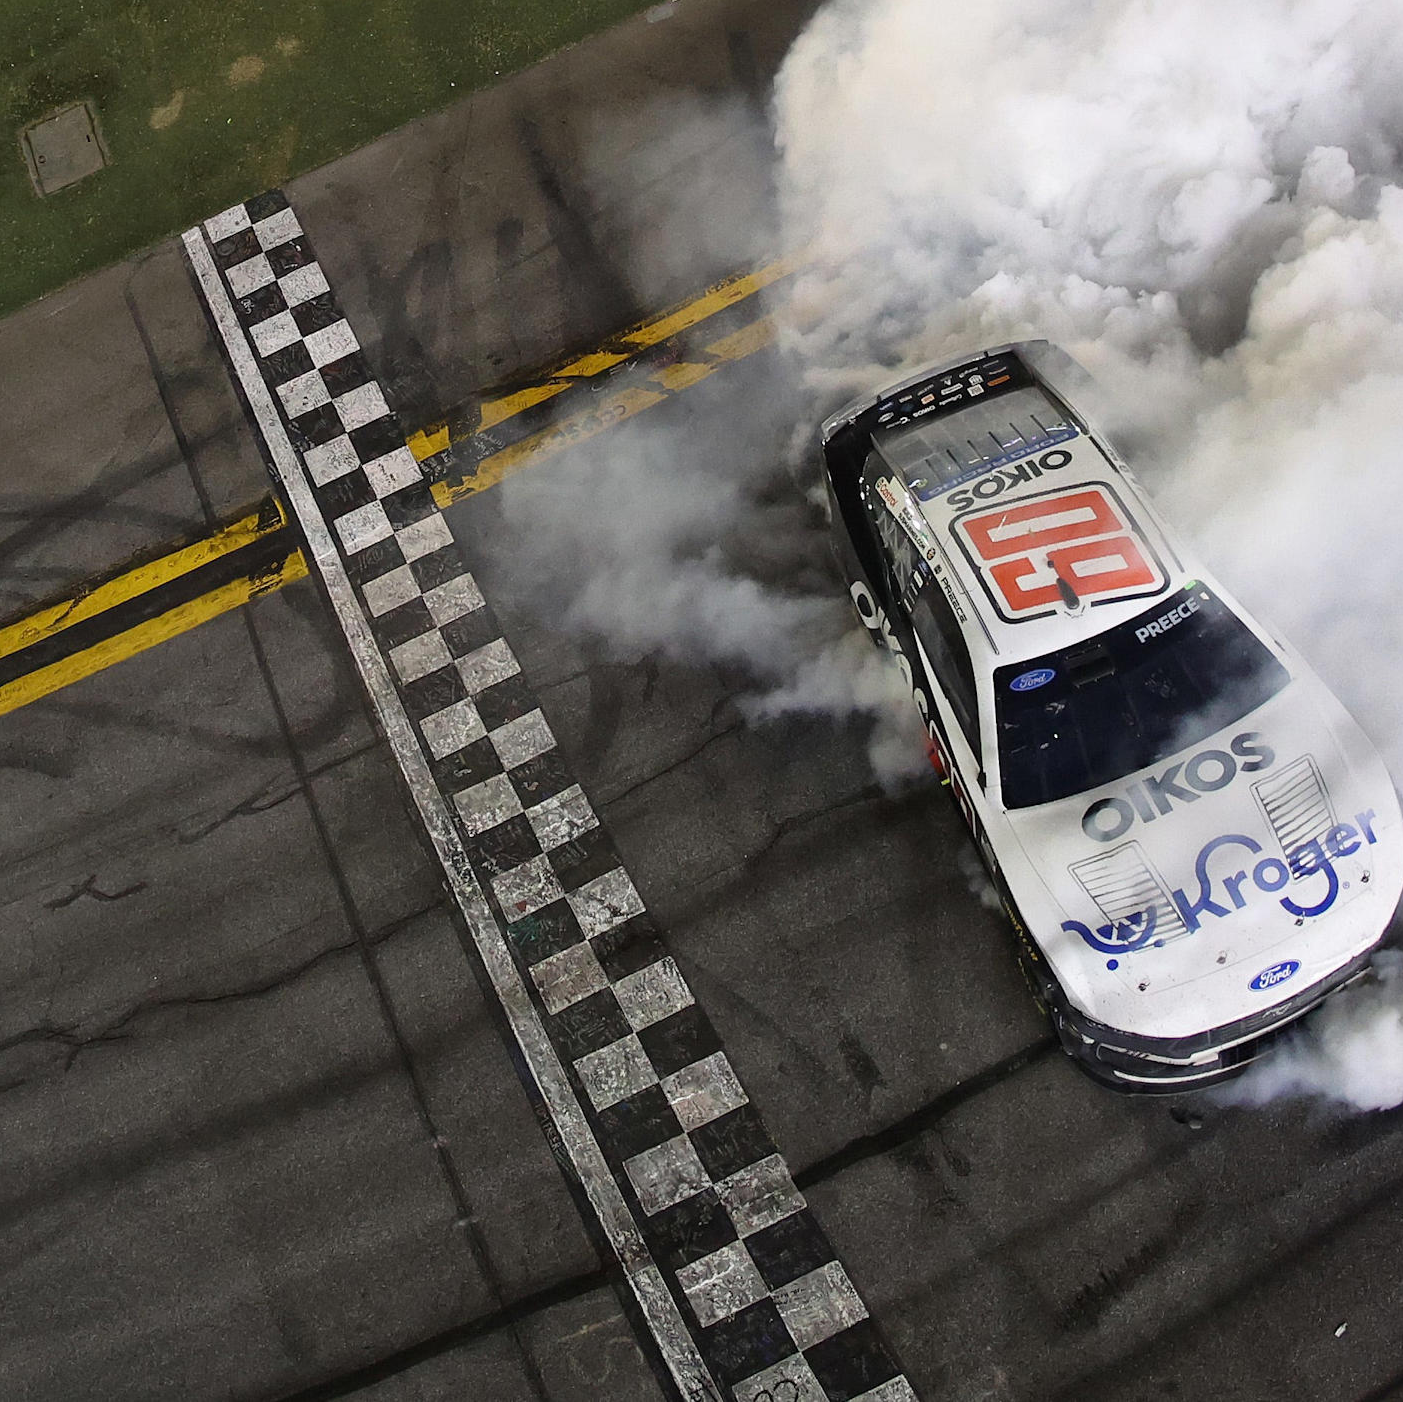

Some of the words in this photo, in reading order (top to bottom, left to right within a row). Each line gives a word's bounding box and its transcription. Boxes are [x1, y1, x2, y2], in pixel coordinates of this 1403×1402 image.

[946, 449, 1073, 512] OIKOS
[962, 489, 1158, 612] 60
[940, 577, 968, 624] PREECE
[1134, 599, 1200, 645] PREECE
[1081, 732, 1276, 843] OIKOS
[1171, 807, 1379, 935] Kroger
